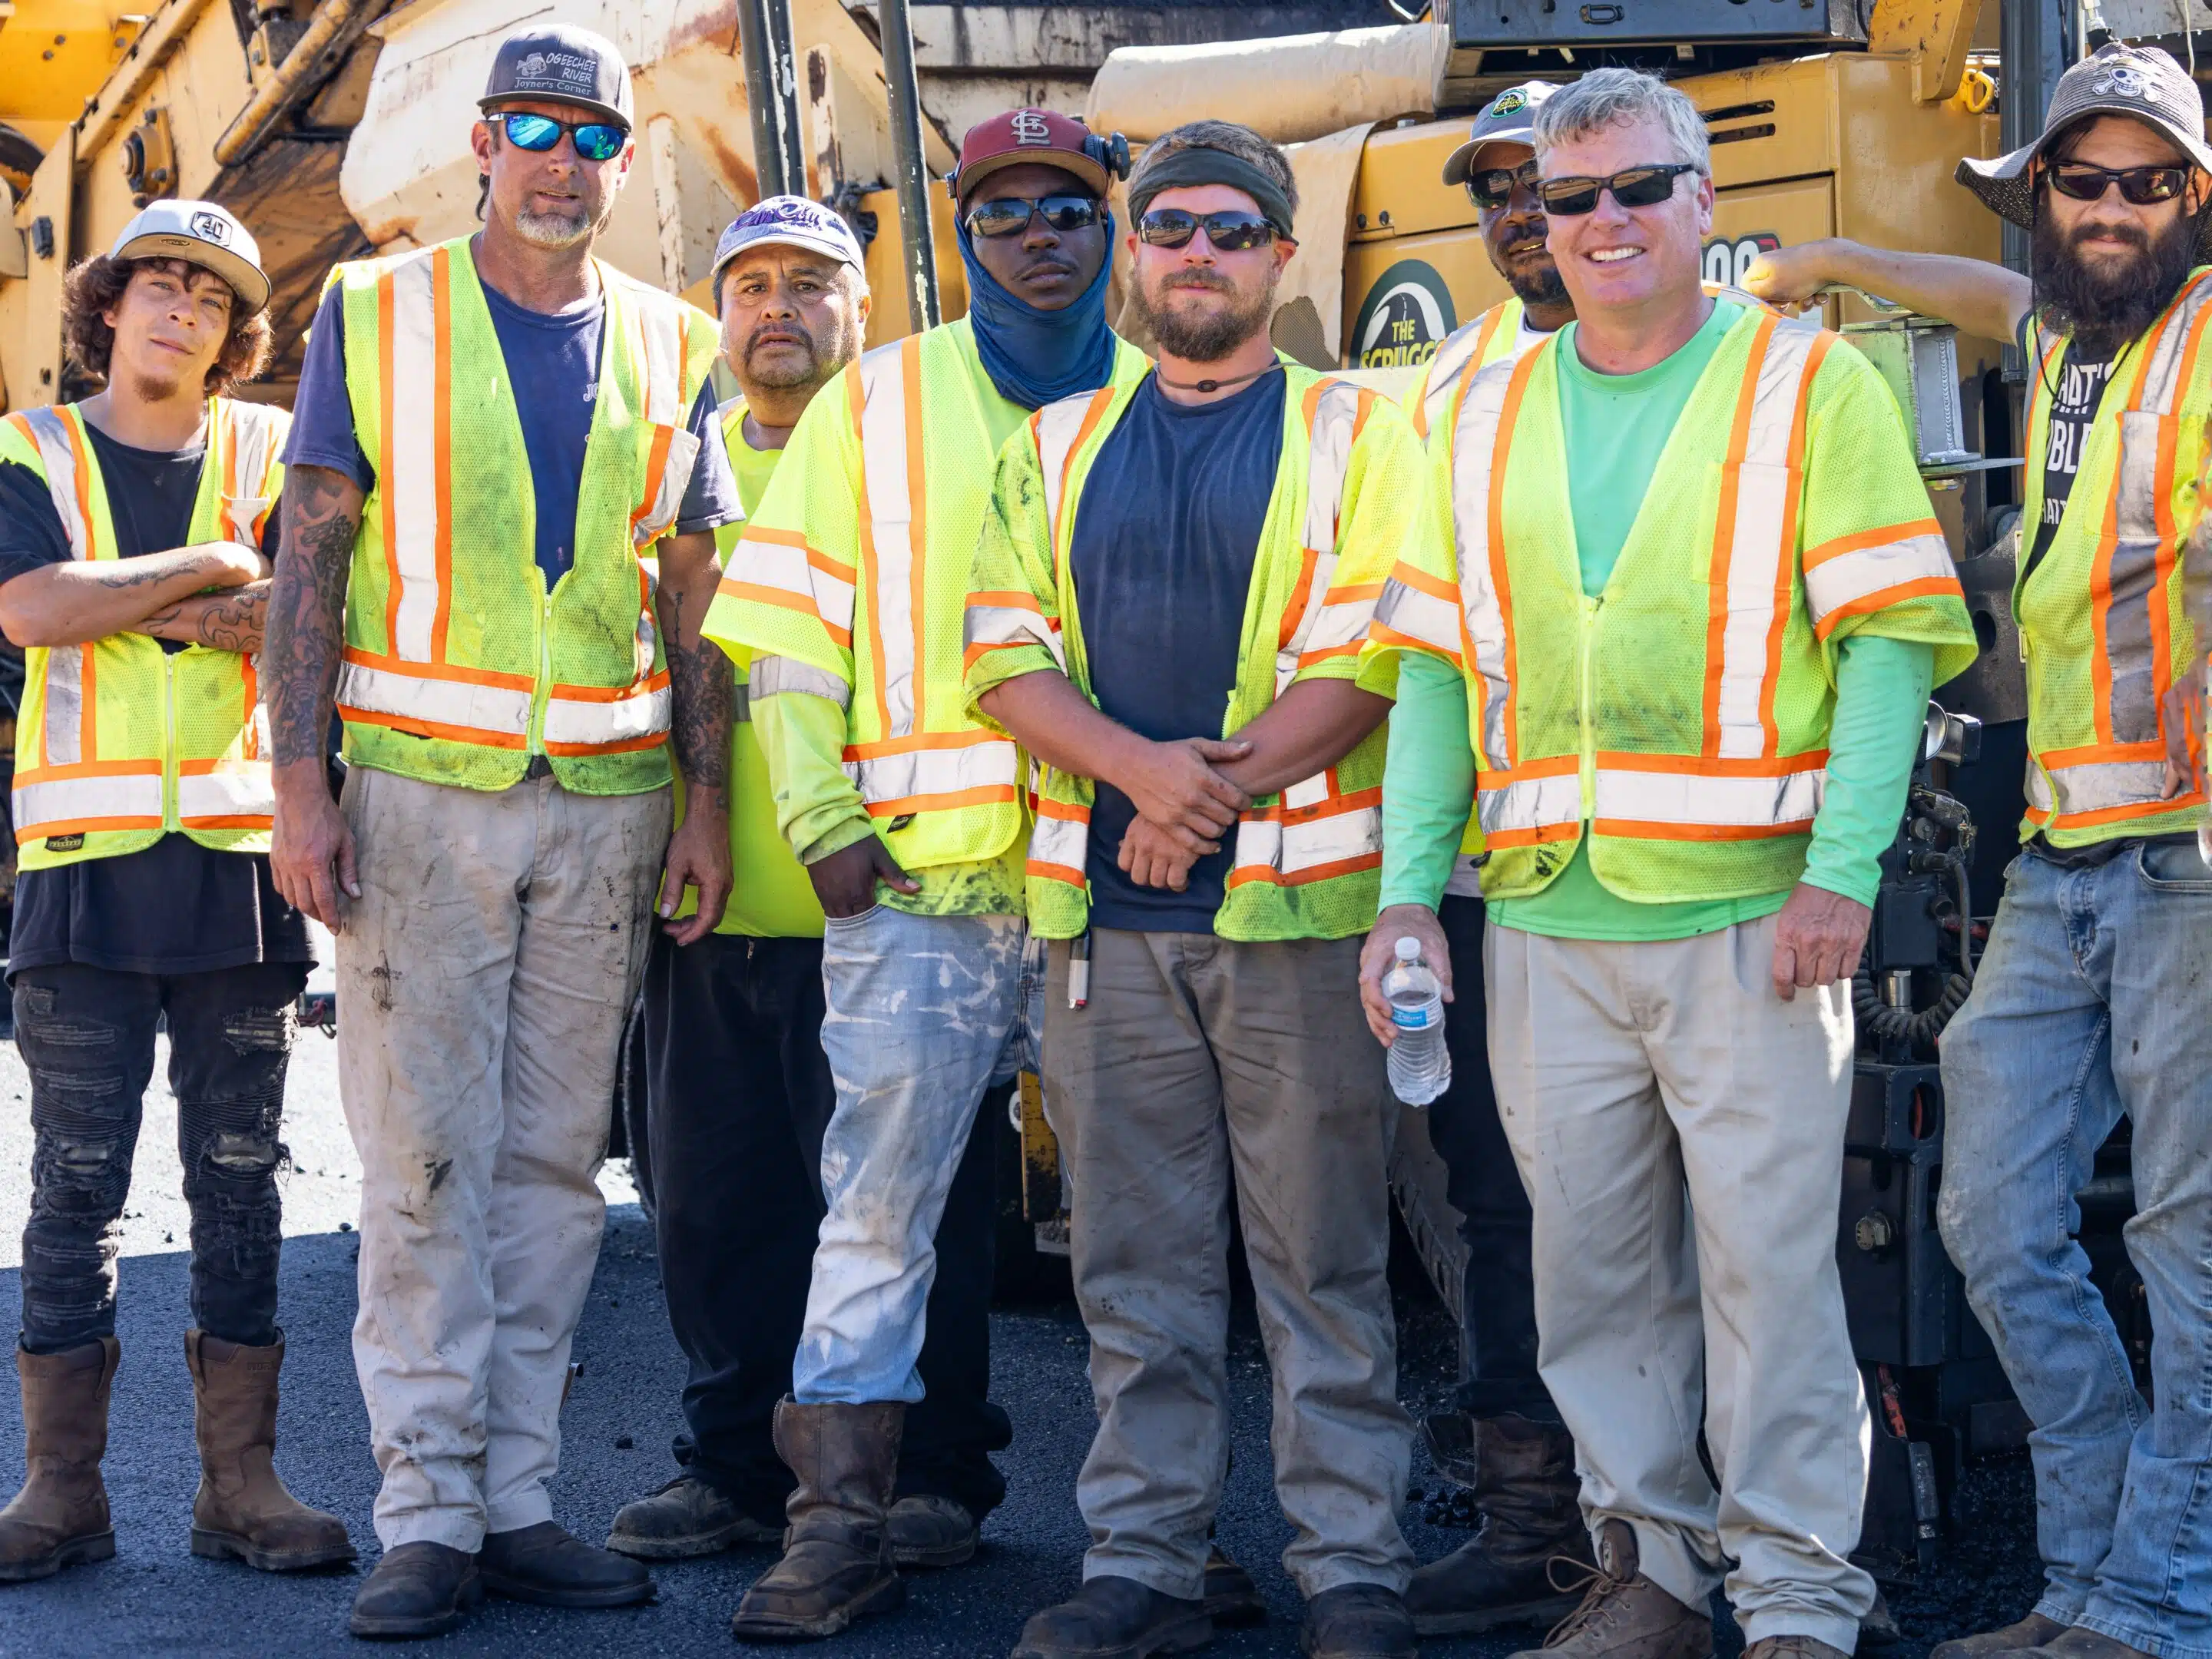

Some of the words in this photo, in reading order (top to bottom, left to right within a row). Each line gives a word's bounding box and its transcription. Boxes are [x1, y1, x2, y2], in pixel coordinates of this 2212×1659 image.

[546, 52, 596, 71] OGEECHEE
[562, 67, 592, 84] RIVER
[515, 79, 553, 89] Joyner's
[556, 81, 591, 95] Corner
[1392, 319, 1416, 343] THE
[1360, 339, 1438, 369] SCRUGG
